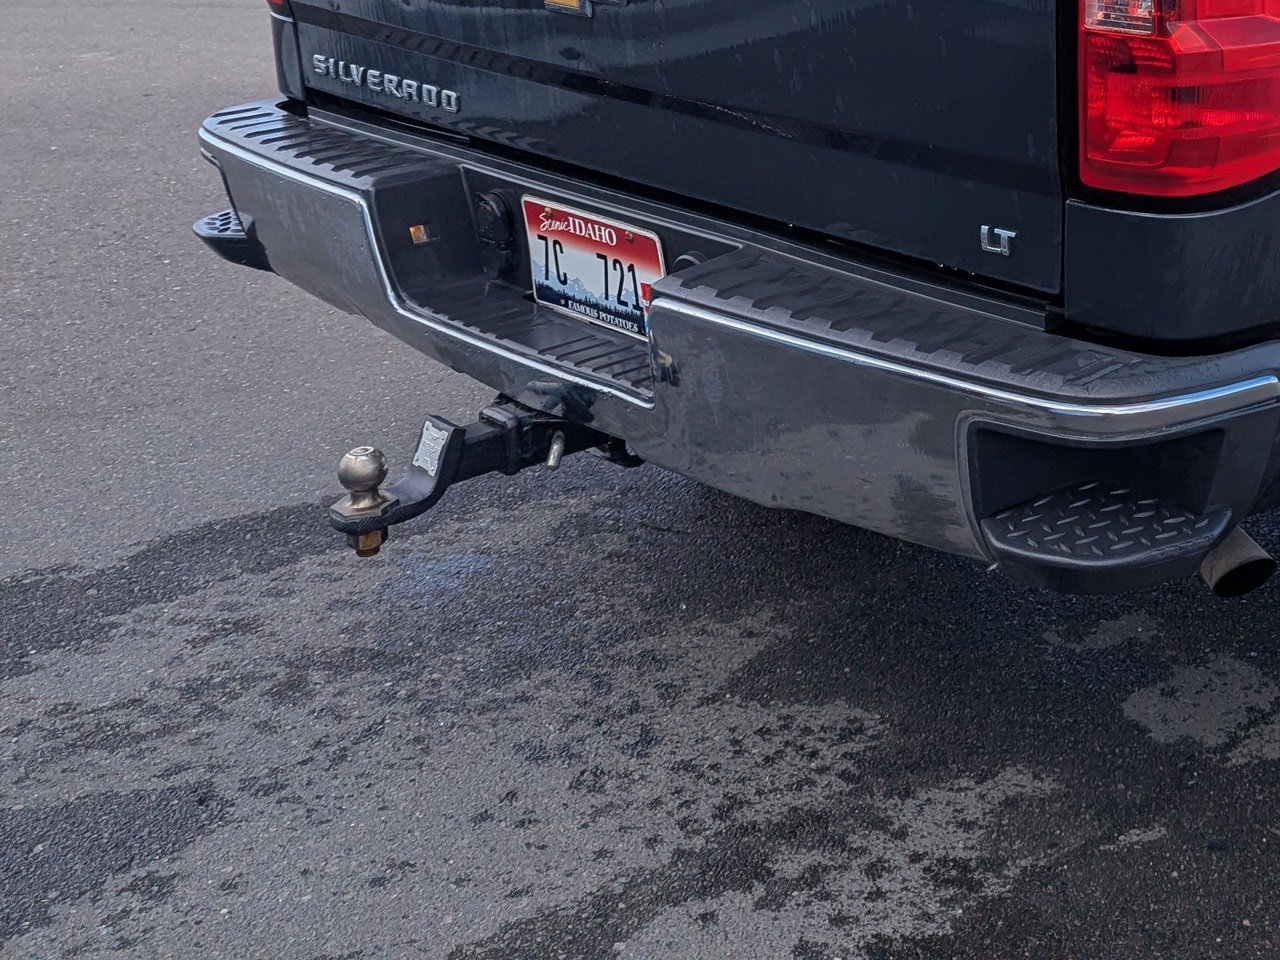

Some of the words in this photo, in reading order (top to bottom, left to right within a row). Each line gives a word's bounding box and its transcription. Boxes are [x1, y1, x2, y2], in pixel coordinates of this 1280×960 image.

[312, 54, 461, 114] SILVERADO
[539, 213, 569, 231] Scenic
[568, 217, 617, 246] IDAHO
[980, 225, 1017, 256] LT
[537, 234, 568, 286] 7C
[596, 253, 644, 311] 721
[568, 300, 598, 320] FAMOUS
[599, 311, 639, 333] POTATOES
